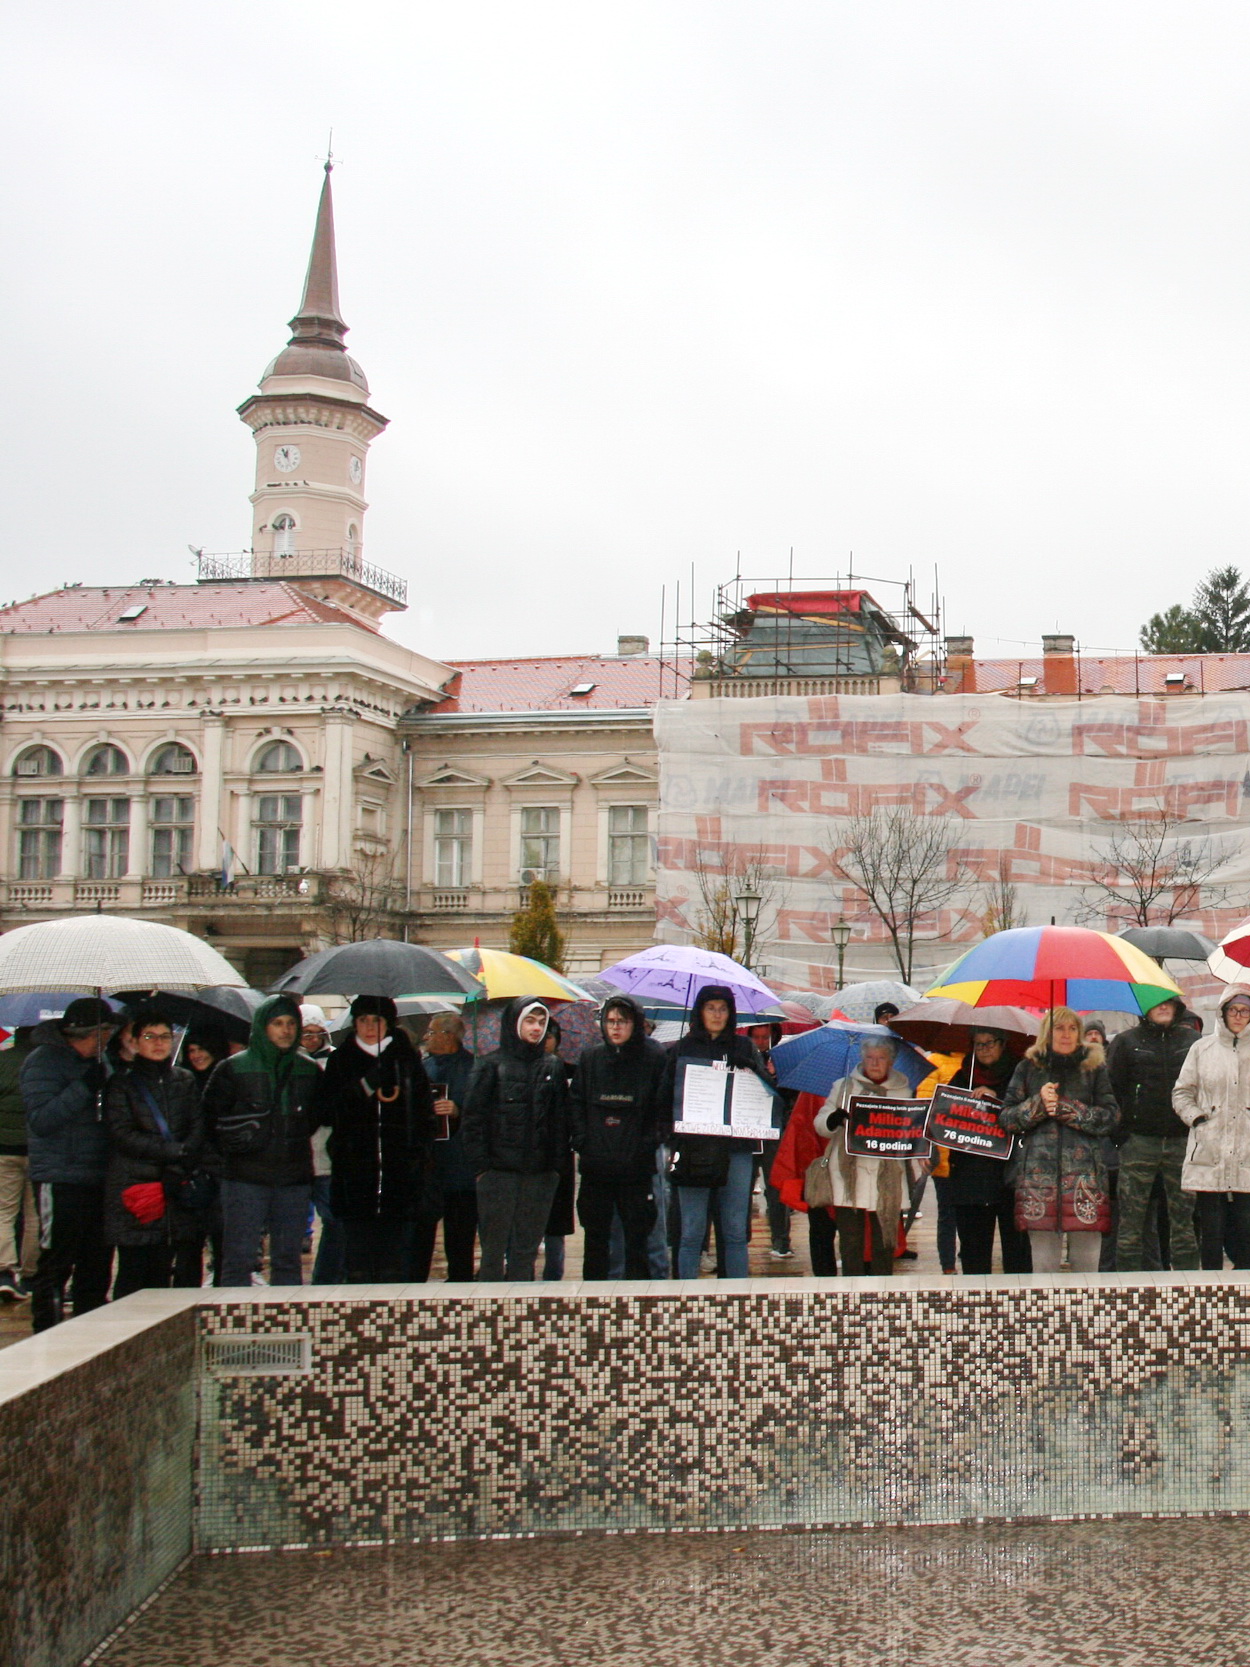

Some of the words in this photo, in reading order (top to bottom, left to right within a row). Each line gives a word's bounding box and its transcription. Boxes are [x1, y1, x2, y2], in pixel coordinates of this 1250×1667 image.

[869, 1112, 913, 1127] Milica
[950, 1103, 997, 1123] Mileva
[855, 1123, 923, 1140] Adamović
[944, 1129, 957, 1140] 76
[957, 1134, 994, 1148] godina
[866, 1140, 878, 1149] 16
[879, 1141, 913, 1152] godina
